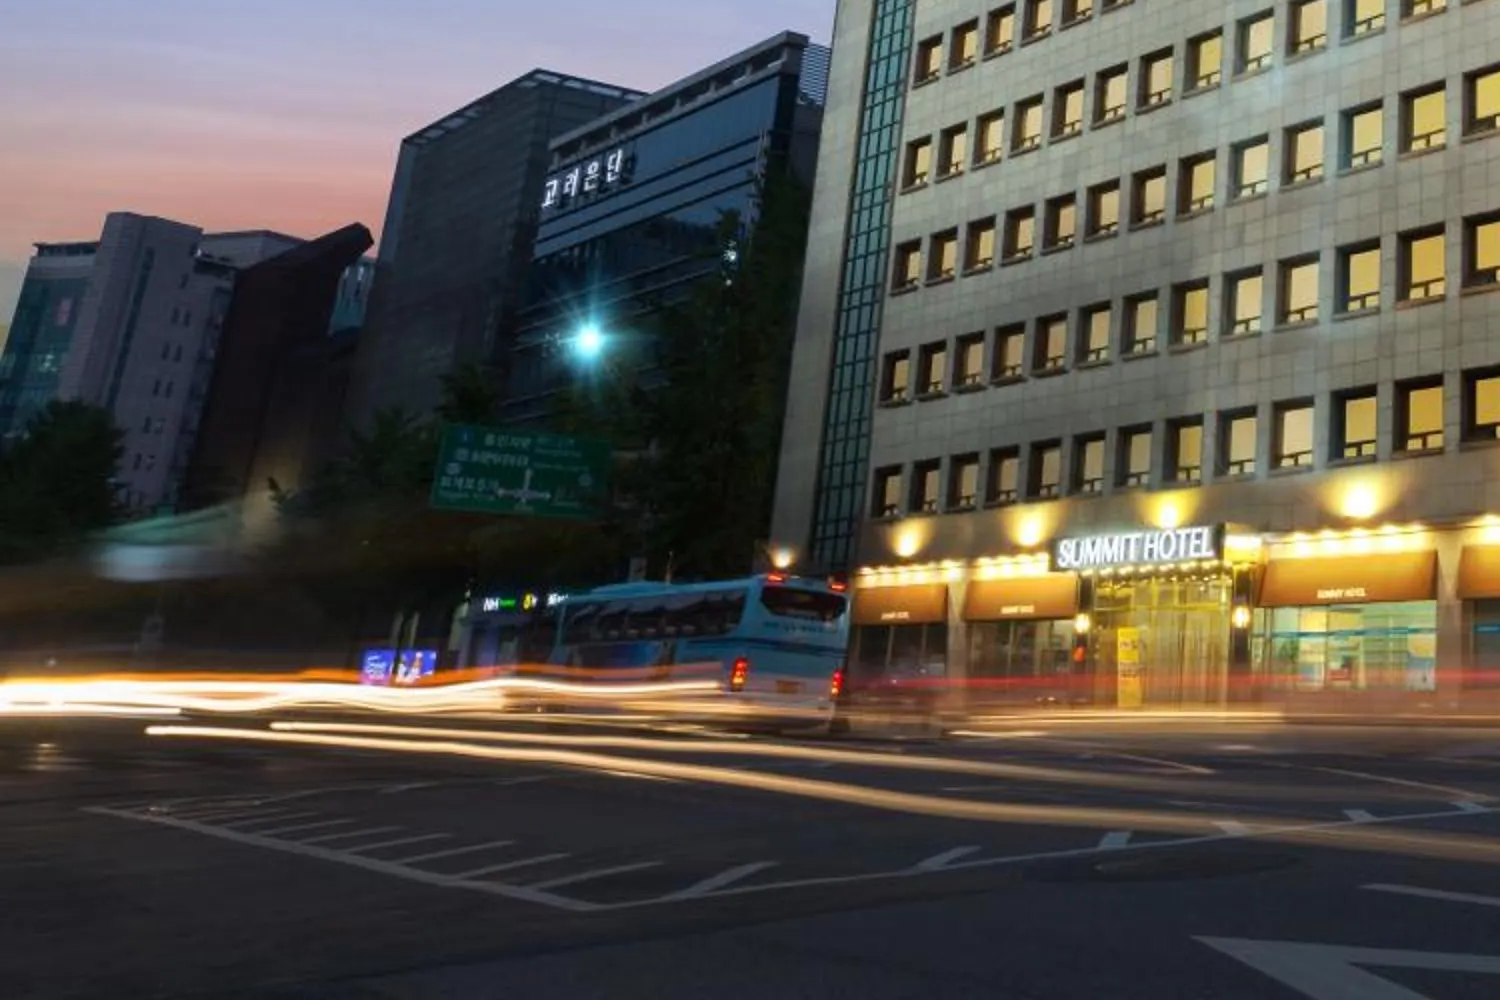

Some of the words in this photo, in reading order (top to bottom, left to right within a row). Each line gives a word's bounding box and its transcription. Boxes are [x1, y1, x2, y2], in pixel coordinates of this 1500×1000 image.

[541, 148, 623, 208] 고려은단
[1057, 532, 1141, 568] SUMMIT
[1143, 525, 1215, 561] HOTEL
